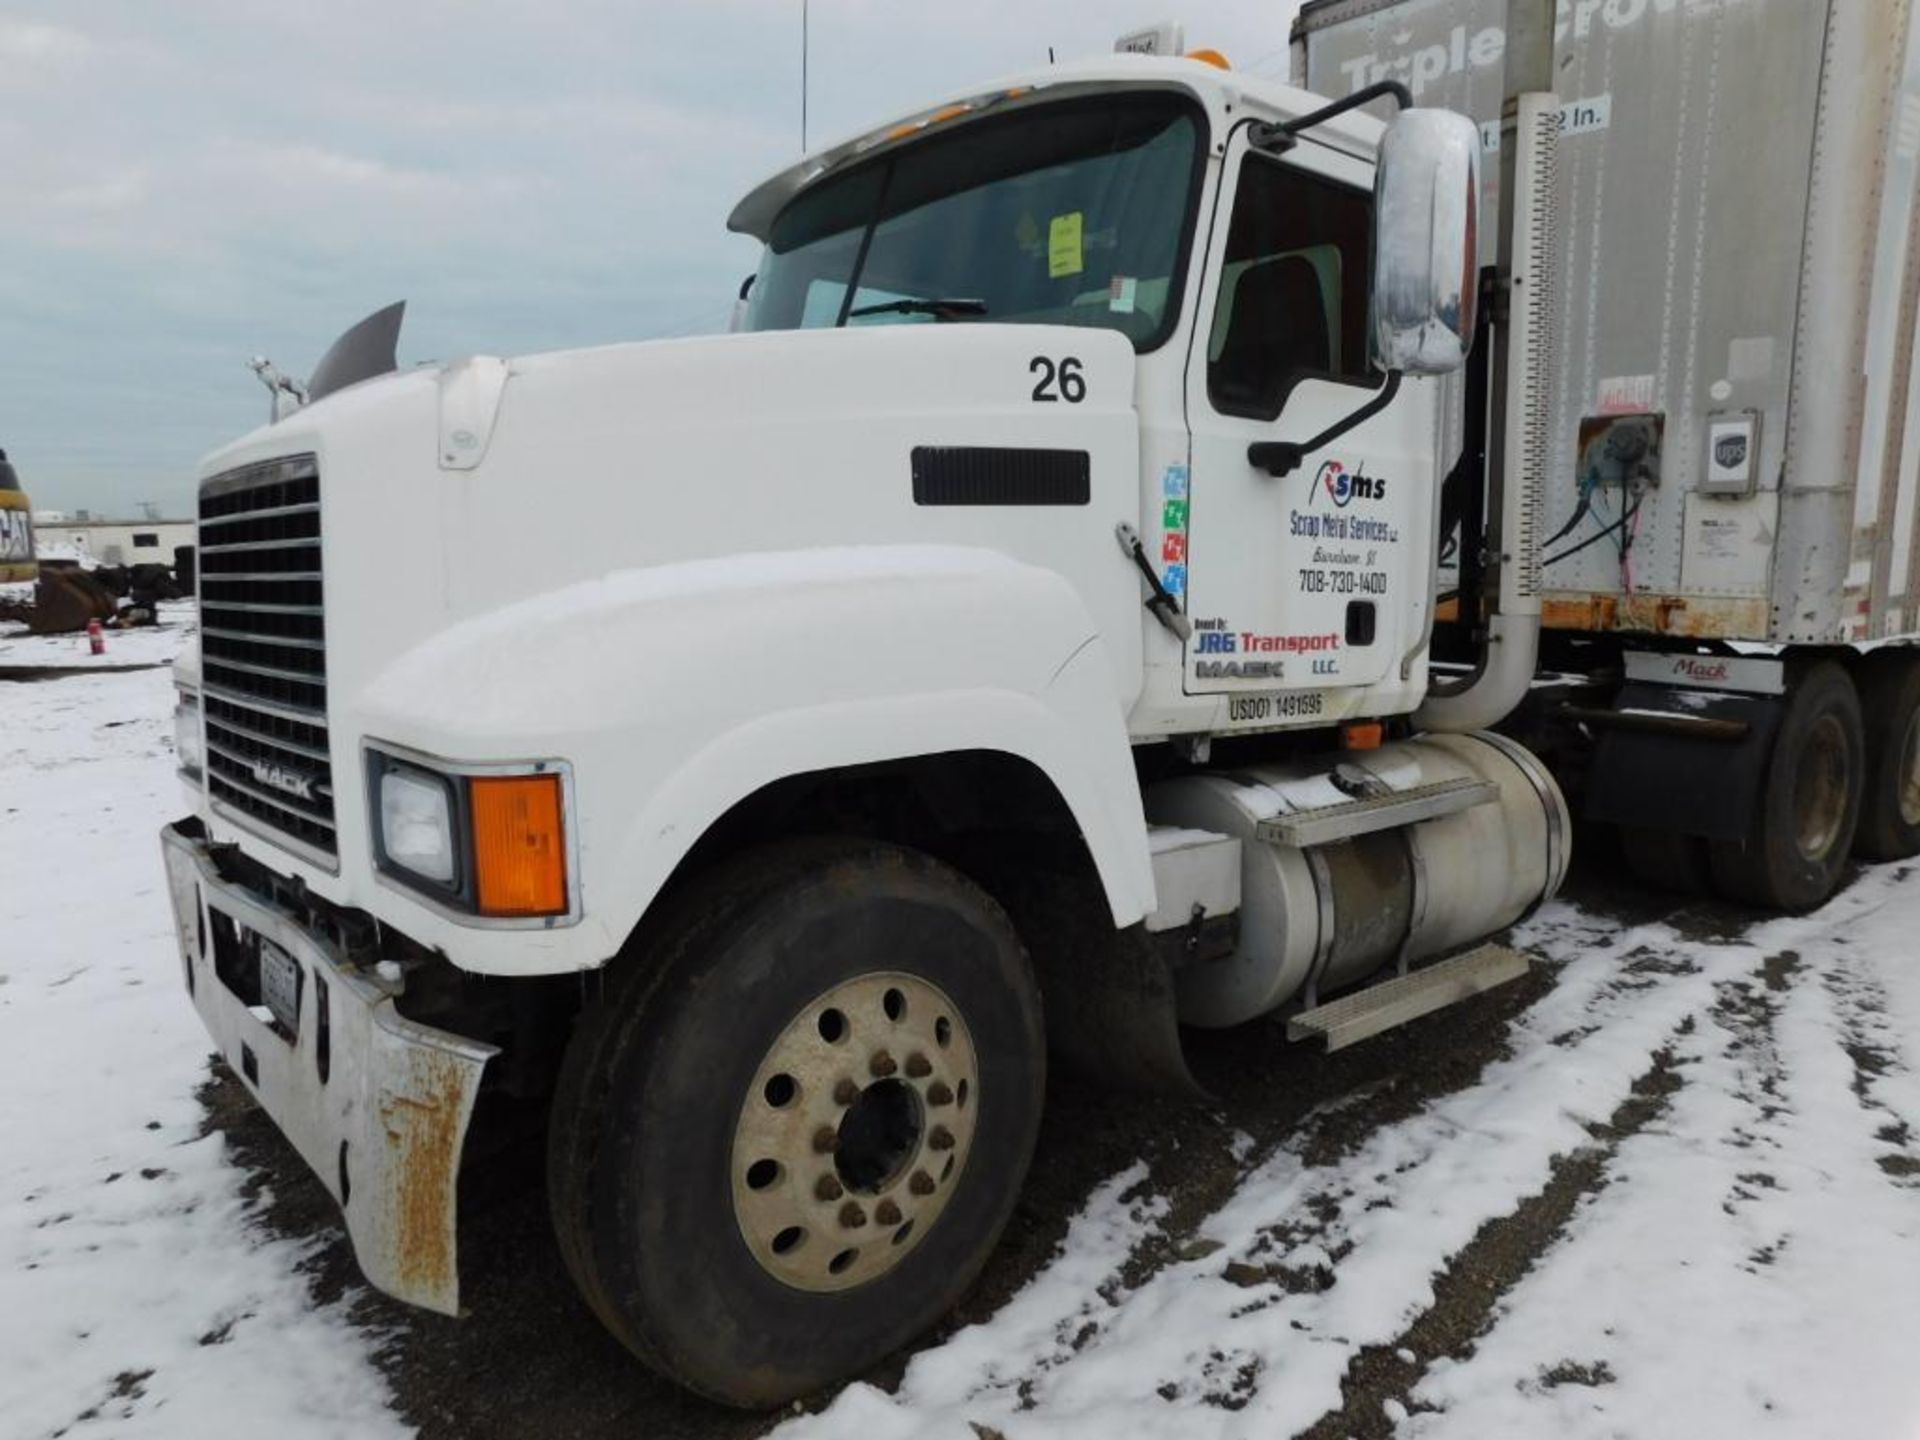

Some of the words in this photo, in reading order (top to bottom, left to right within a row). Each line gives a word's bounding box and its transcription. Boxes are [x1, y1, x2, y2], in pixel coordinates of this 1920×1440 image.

[1573, 107, 1602, 127] In.
[1030, 355, 1087, 404] 26
[1334, 473, 1386, 501] sms
[1290, 509, 1321, 540] Scrap
[1322, 513, 1348, 540] Metal
[1350, 514, 1389, 542] Services
[1299, 568, 1388, 595] 708-730-1400
[1241, 631, 1341, 656] Transport
